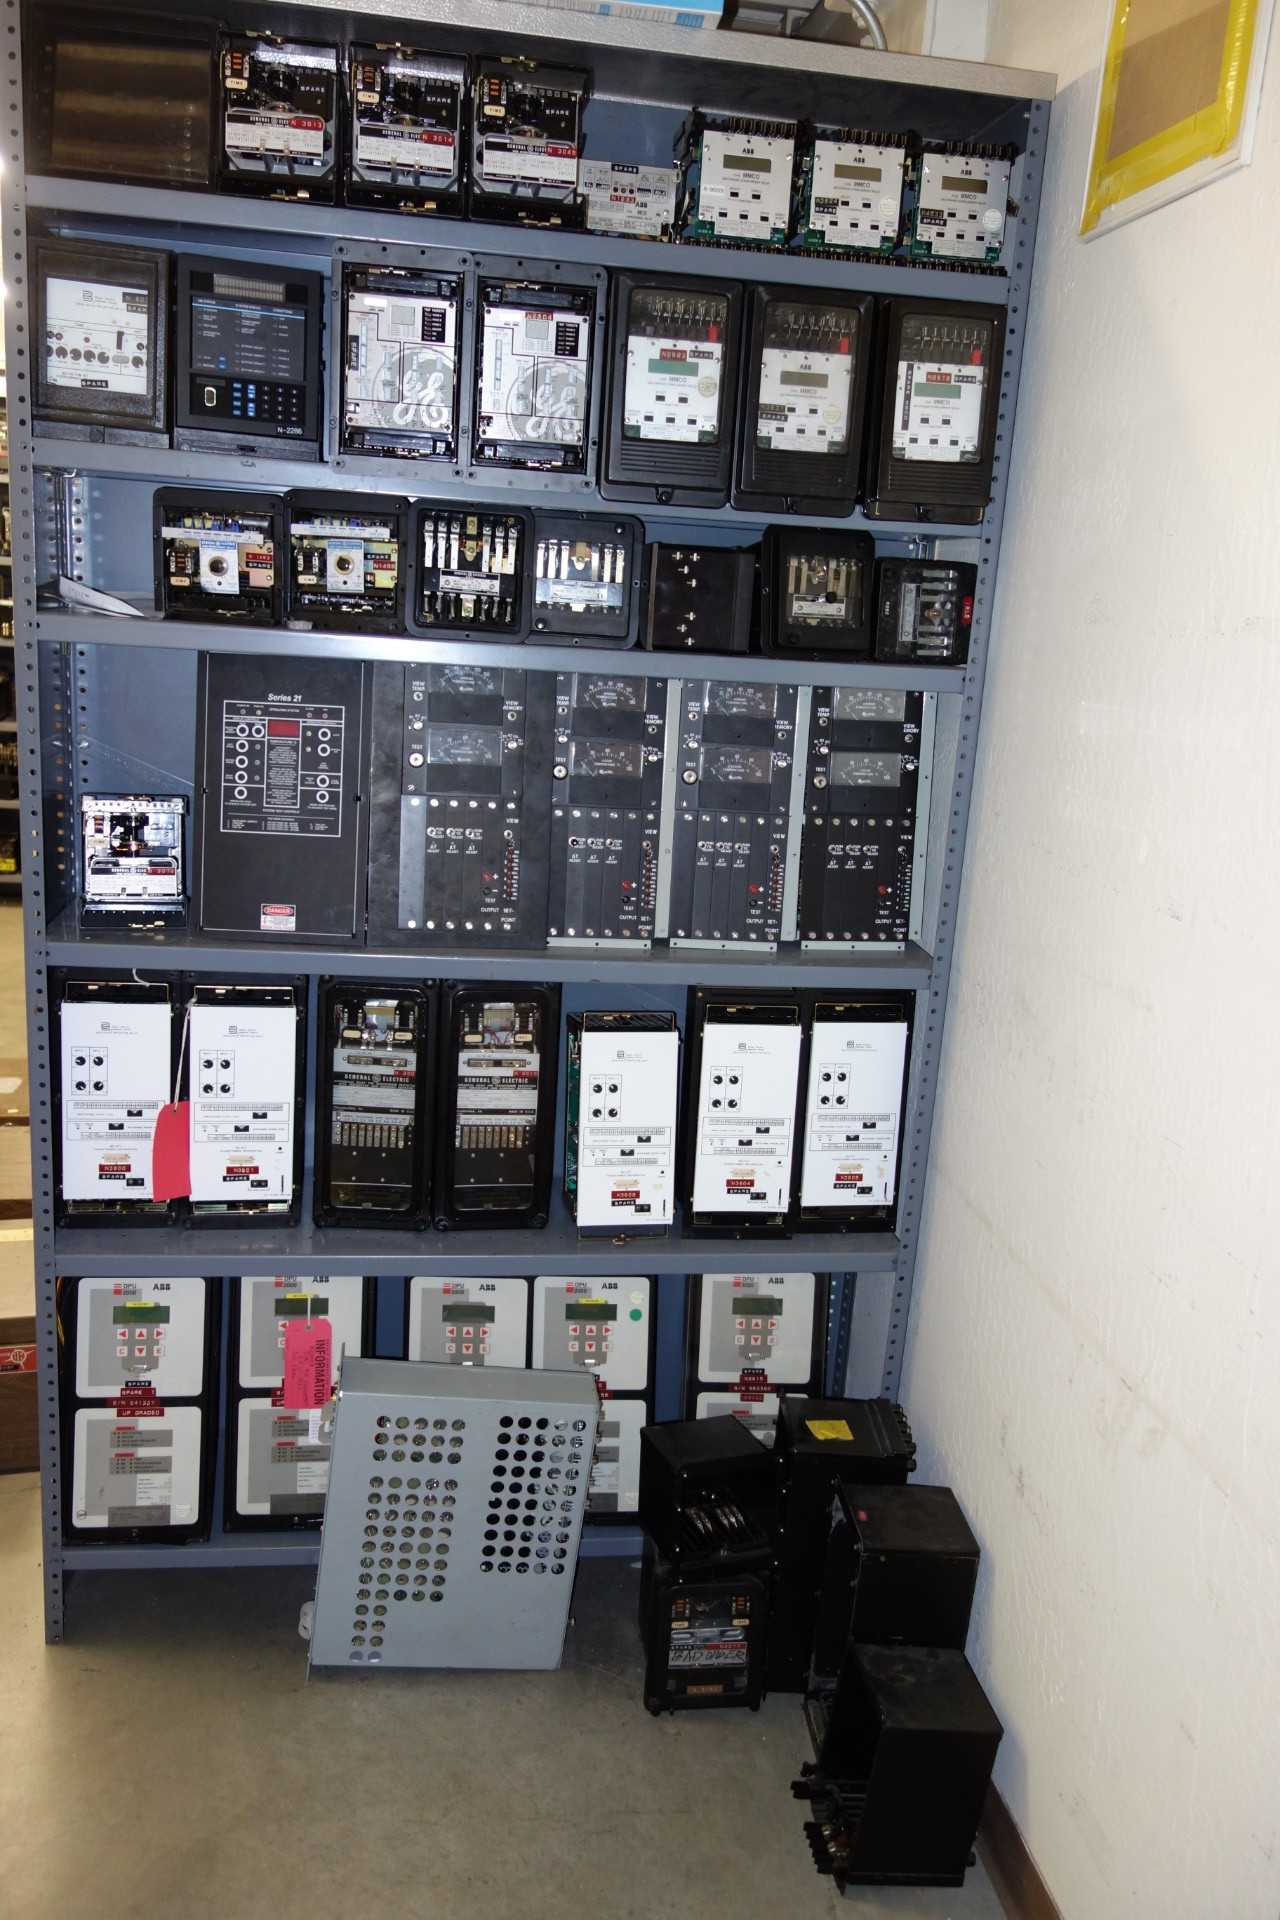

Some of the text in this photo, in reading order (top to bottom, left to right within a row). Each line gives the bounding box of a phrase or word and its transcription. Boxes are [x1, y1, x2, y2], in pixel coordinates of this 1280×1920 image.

[426, 96, 452, 104] SPARE
[742, 147, 755, 155] ABB
[853, 156, 866, 164] ABB
[815, 206, 837, 215] SPARE
[922, 218, 945, 226] SPARE
[81, 380, 107, 388] SPARE
[267, 691, 292, 703] Series
[344, 1073, 410, 1084] GENERAL ELECTRIC
[312, 1275, 330, 1283] ABB
[153, 1283, 172, 1291] ABB
[313, 1339, 326, 1405] INFORMATION
